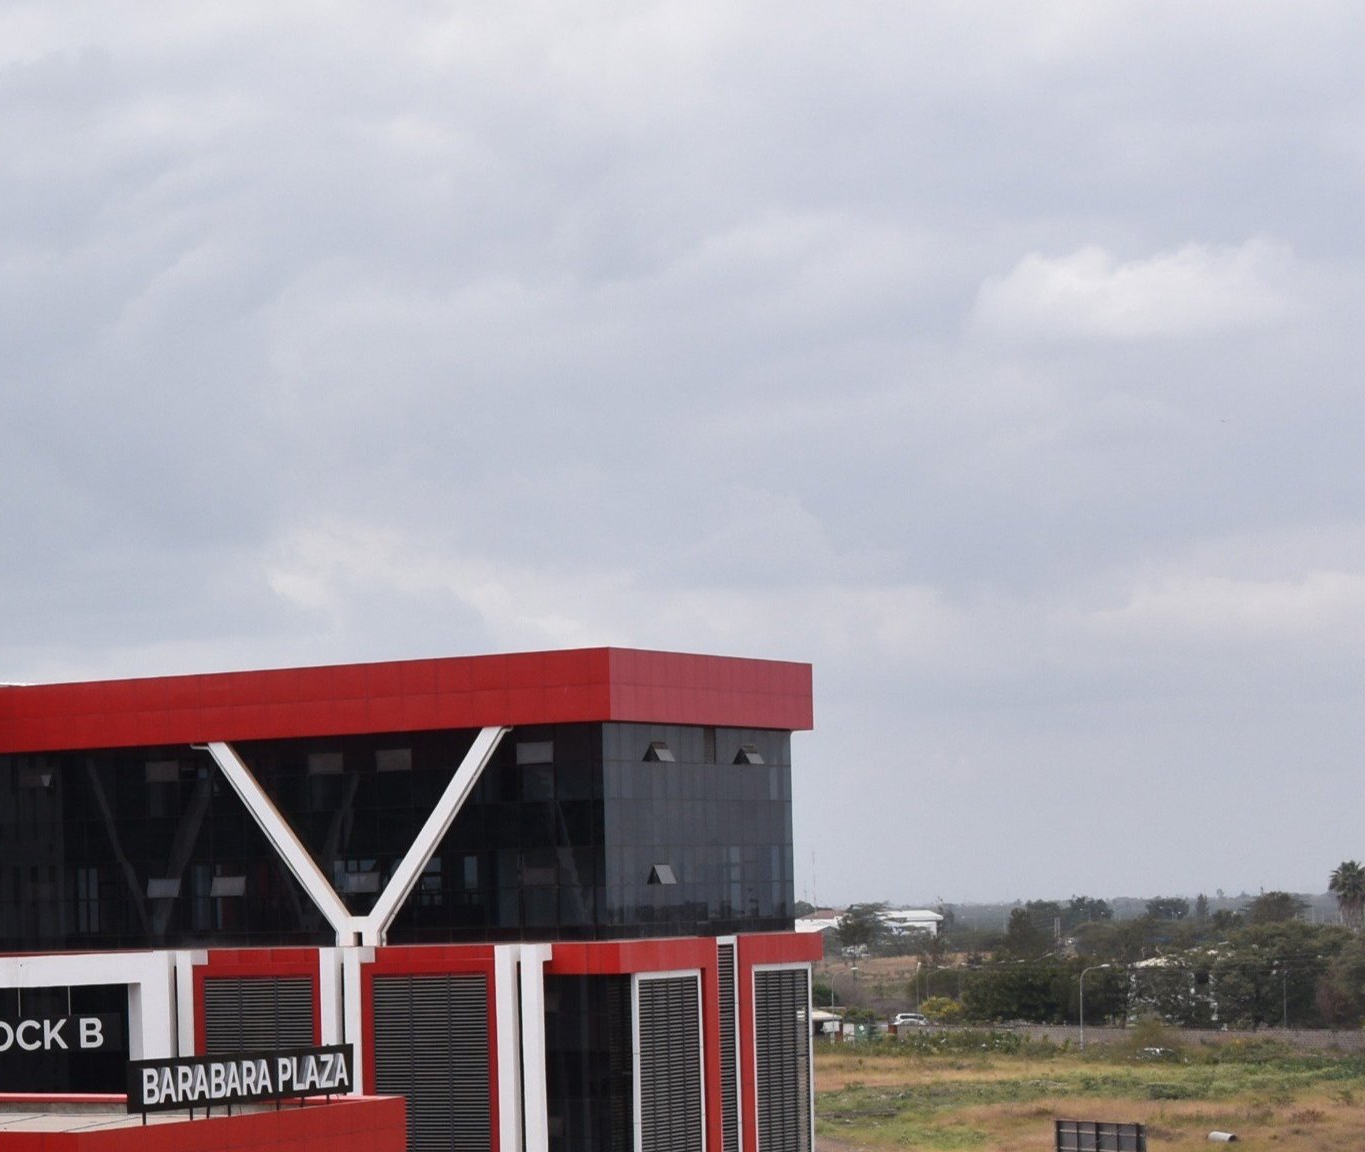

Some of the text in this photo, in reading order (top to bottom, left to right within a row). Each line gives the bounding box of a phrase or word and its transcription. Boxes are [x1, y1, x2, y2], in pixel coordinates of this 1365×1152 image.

[79, 1017, 104, 1049] B
[142, 1053, 349, 1105] BARABARA PLAZA
